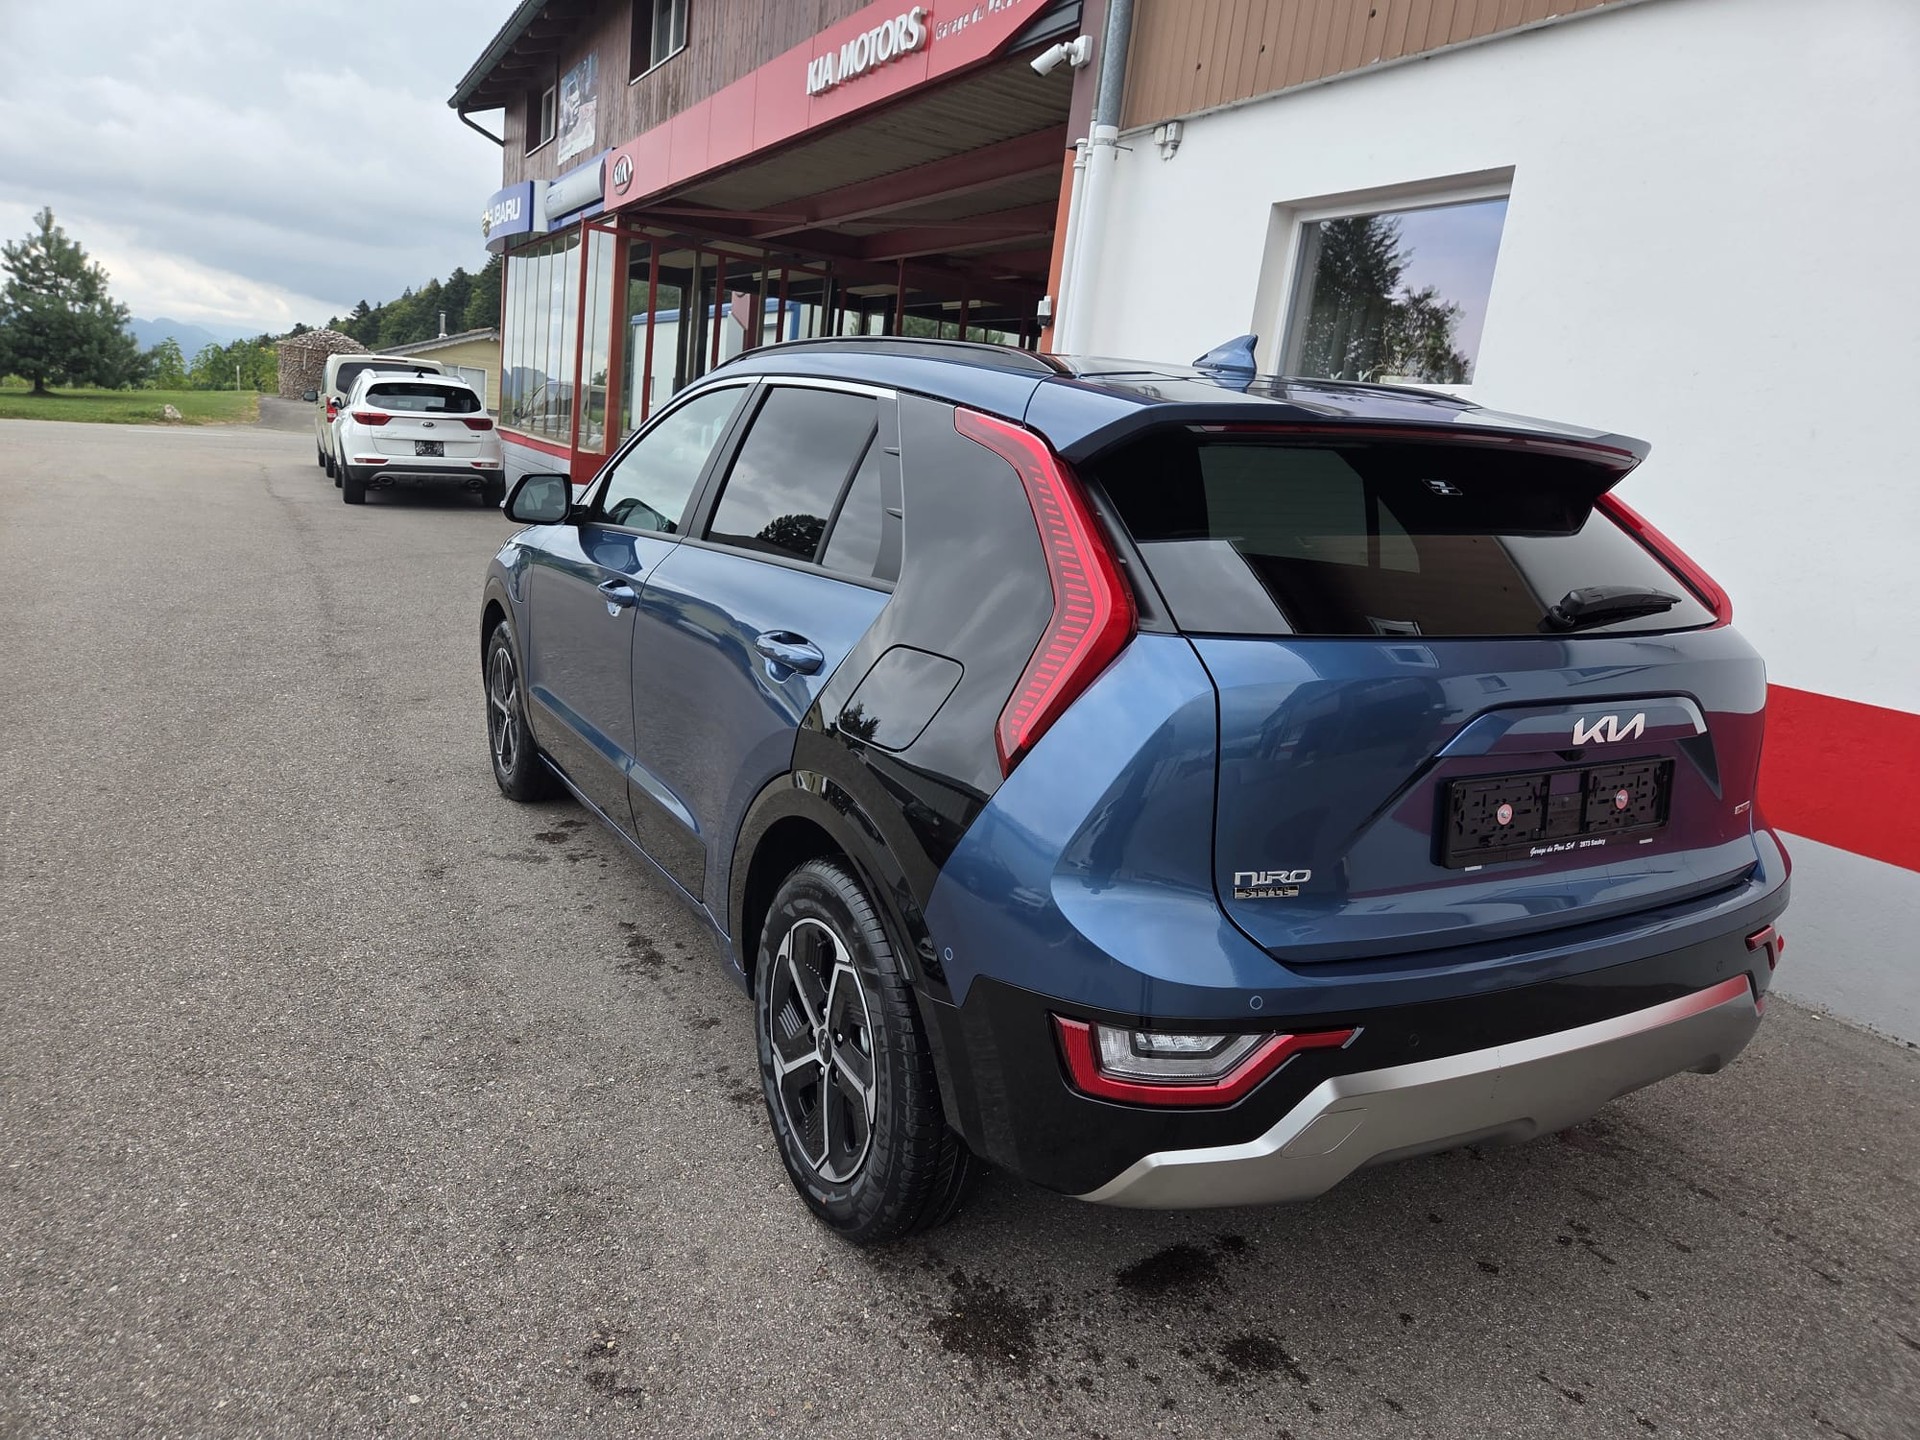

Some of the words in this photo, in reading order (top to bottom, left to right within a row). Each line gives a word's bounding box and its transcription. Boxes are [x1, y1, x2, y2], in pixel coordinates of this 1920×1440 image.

[935, 13, 970, 41] Garage
[806, 52, 839, 95] KIA
[837, 6, 928, 80] MOTORS
[488, 197, 521, 229] UBARU
[1572, 712, 1646, 746] KIA
[1234, 869, 1312, 887] NIRO
